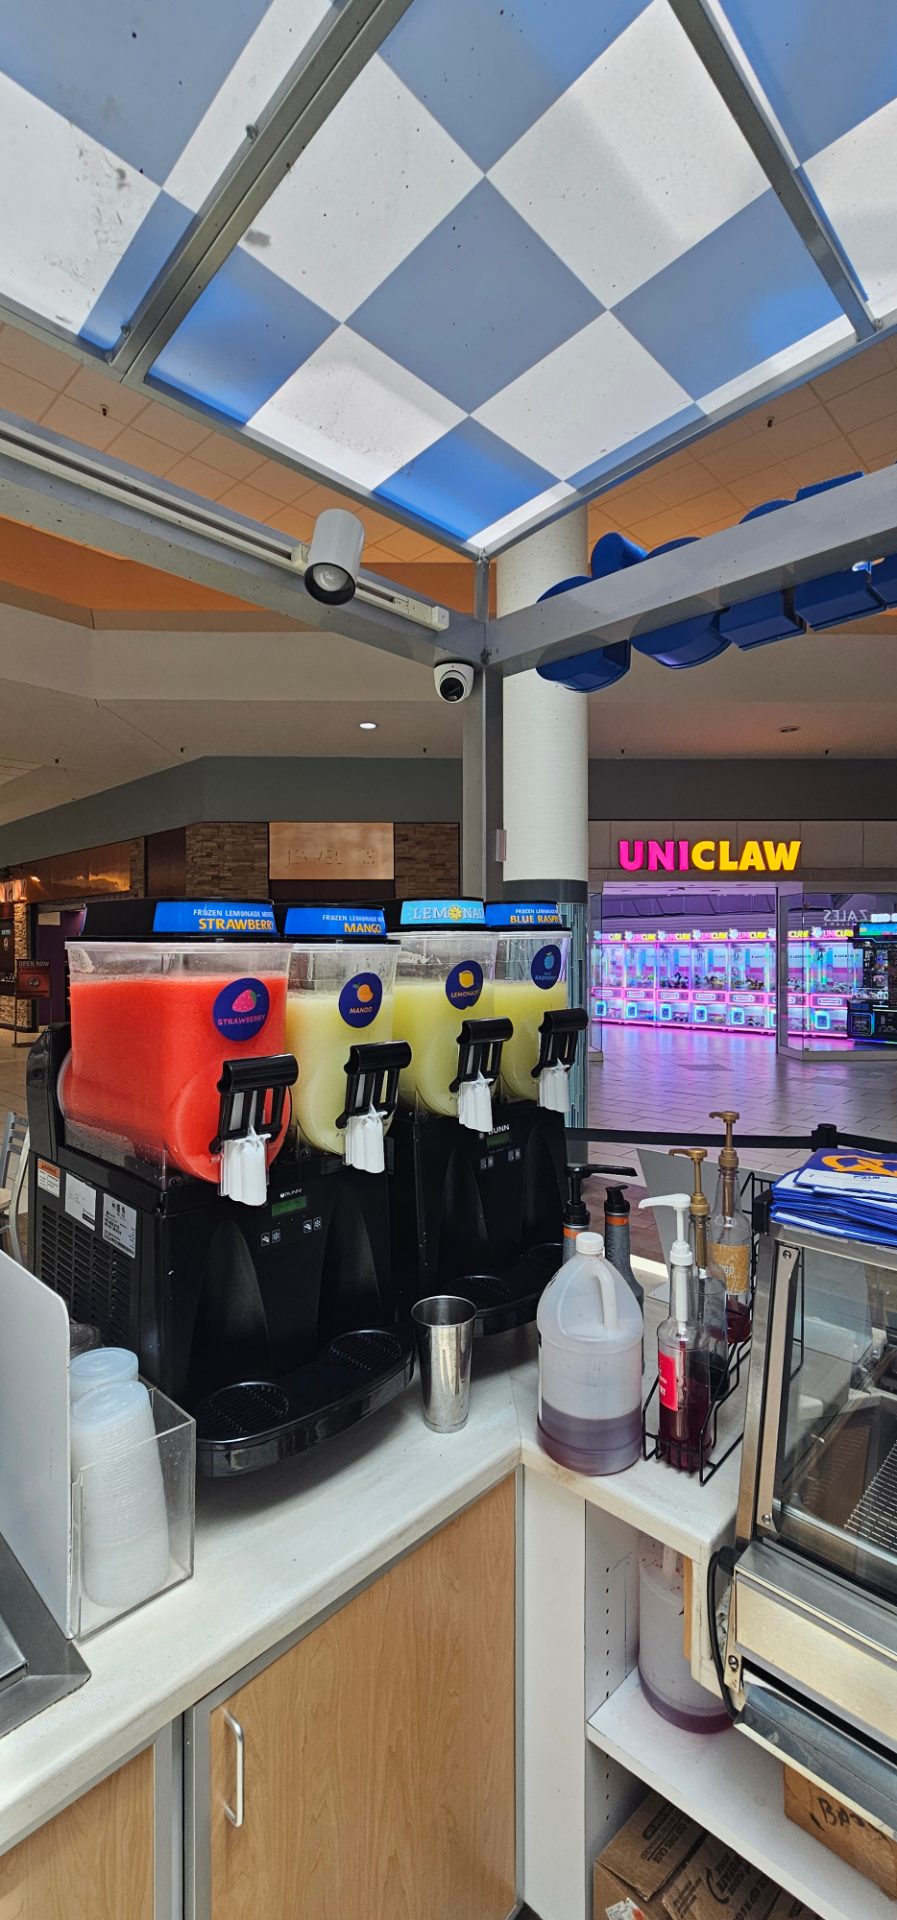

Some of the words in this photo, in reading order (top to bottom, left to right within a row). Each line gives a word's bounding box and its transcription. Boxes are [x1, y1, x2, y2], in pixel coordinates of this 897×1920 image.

[618, 840, 801, 871] UNICLAW
[413, 905, 484, 922] LEMONAD
[510, 915, 534, 924] BLUE
[344, 922, 381, 933] MANGO
[349, 1006, 373, 1014] MANGO
[217, 1013, 265, 1027] STRAWBERRY
